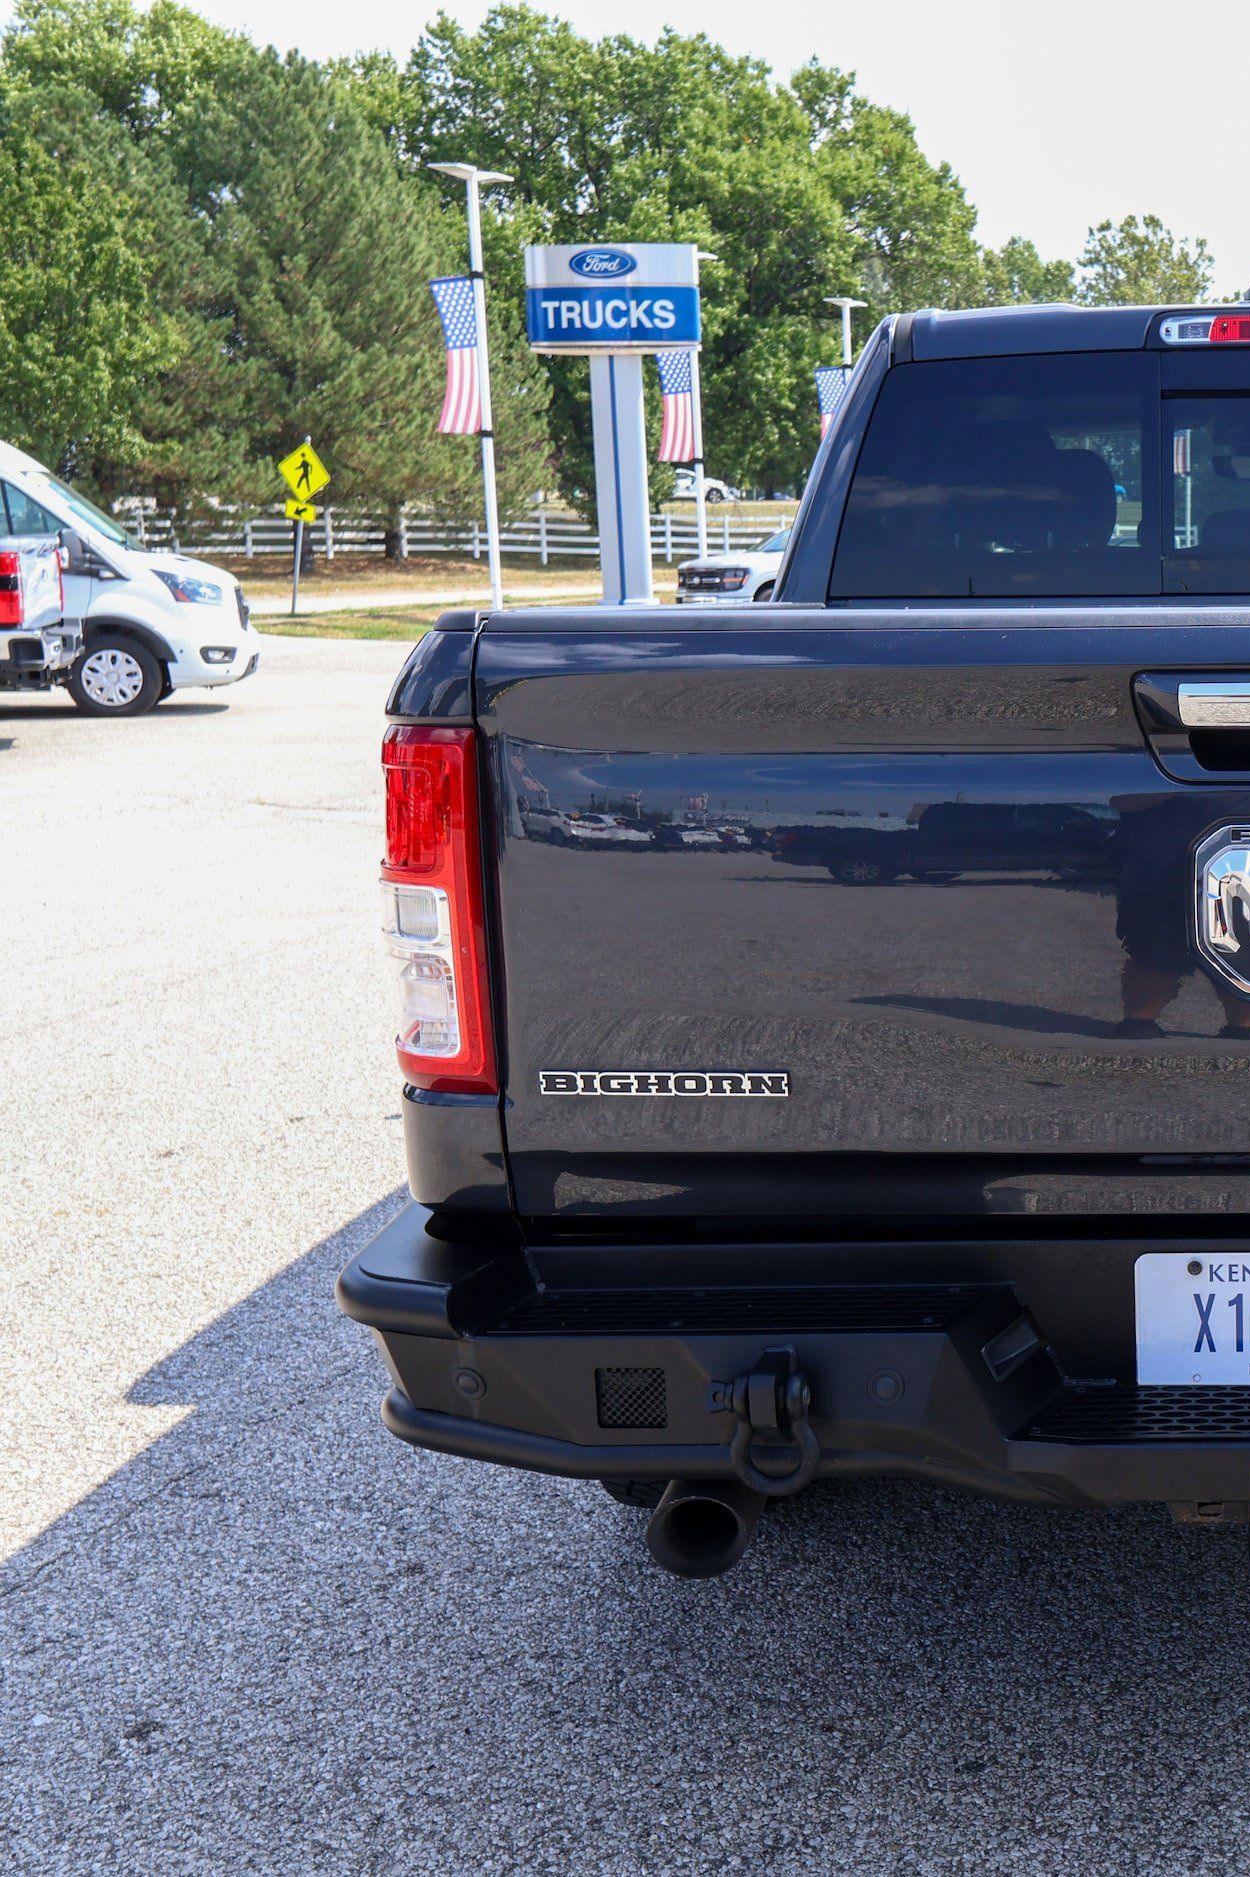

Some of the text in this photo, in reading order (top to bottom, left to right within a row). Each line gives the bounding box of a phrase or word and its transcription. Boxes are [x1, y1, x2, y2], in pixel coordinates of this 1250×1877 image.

[582, 254, 620, 272] Ford
[541, 299, 676, 329] TRUCKS
[539, 1071, 789, 1097] BIGHORN
